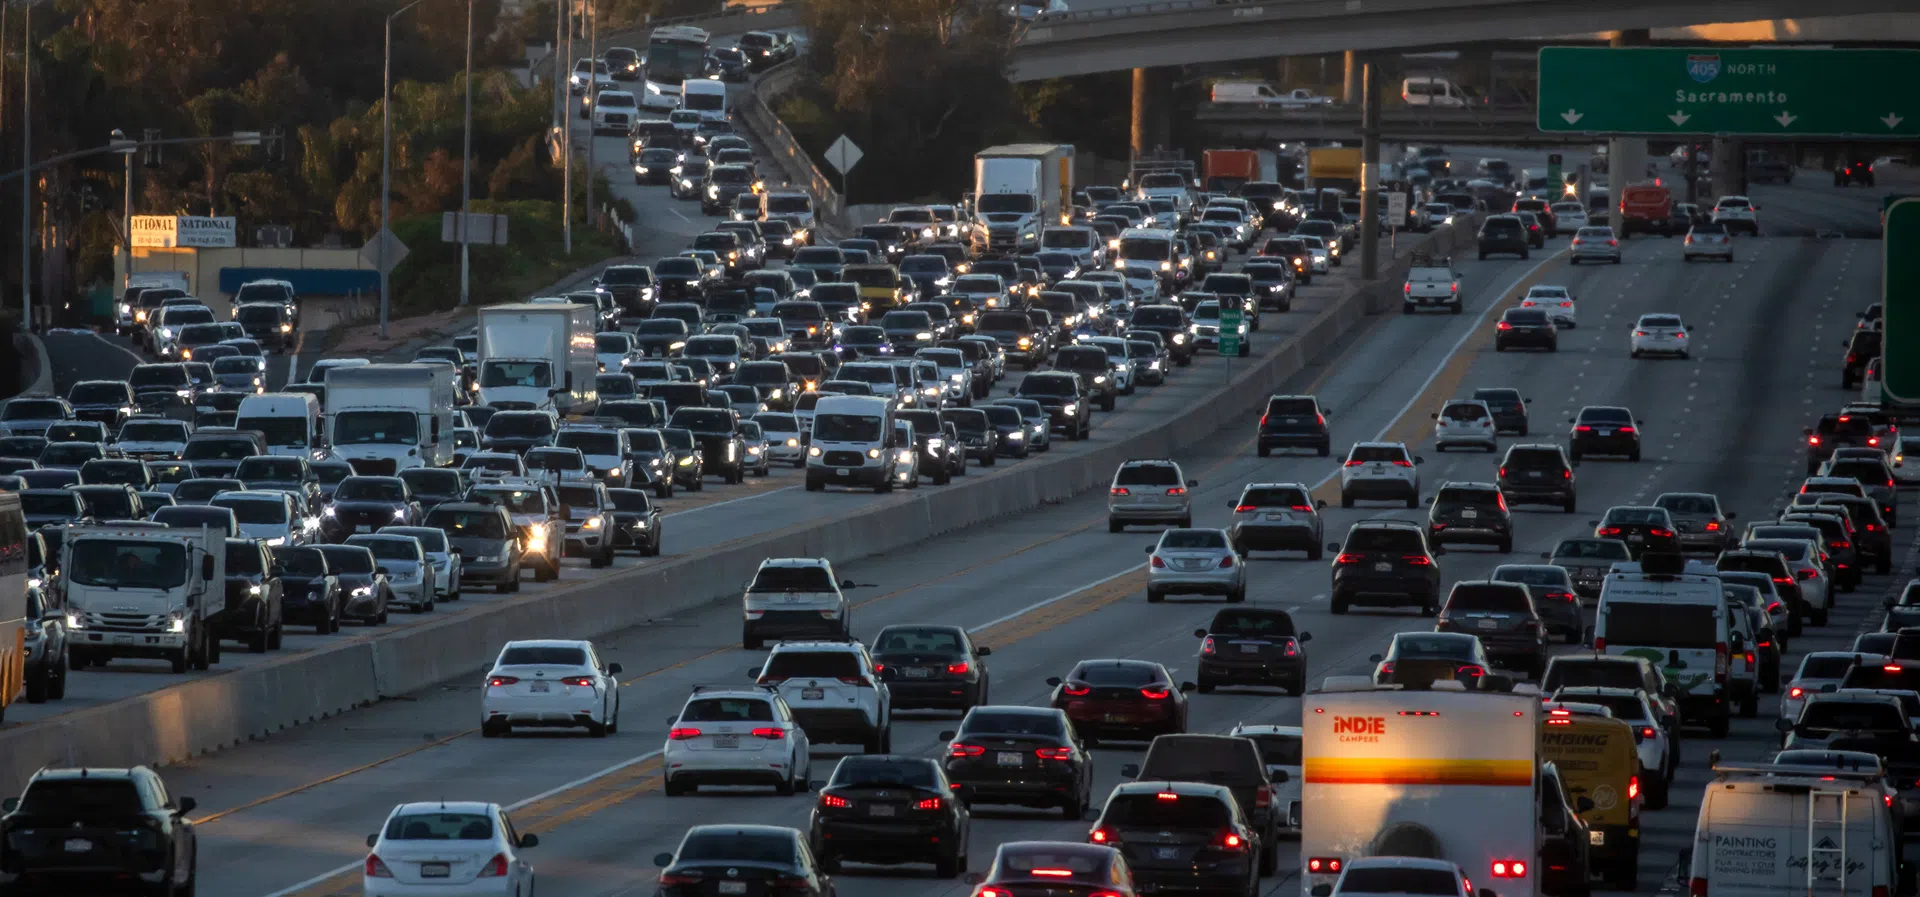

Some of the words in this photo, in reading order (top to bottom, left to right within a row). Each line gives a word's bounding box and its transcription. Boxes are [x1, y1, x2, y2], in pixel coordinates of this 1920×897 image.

[1691, 63, 1718, 75] 405
[1727, 64, 1777, 75] NORTH
[1676, 89, 1788, 104] Sacramento
[131, 218, 174, 231] ATIONAL
[180, 218, 232, 230] NATIONAL
[1339, 735, 1379, 743] CAMPERS
[1715, 836, 1776, 849] PAINTING
[1715, 848, 1776, 858] CONTRACTORS
